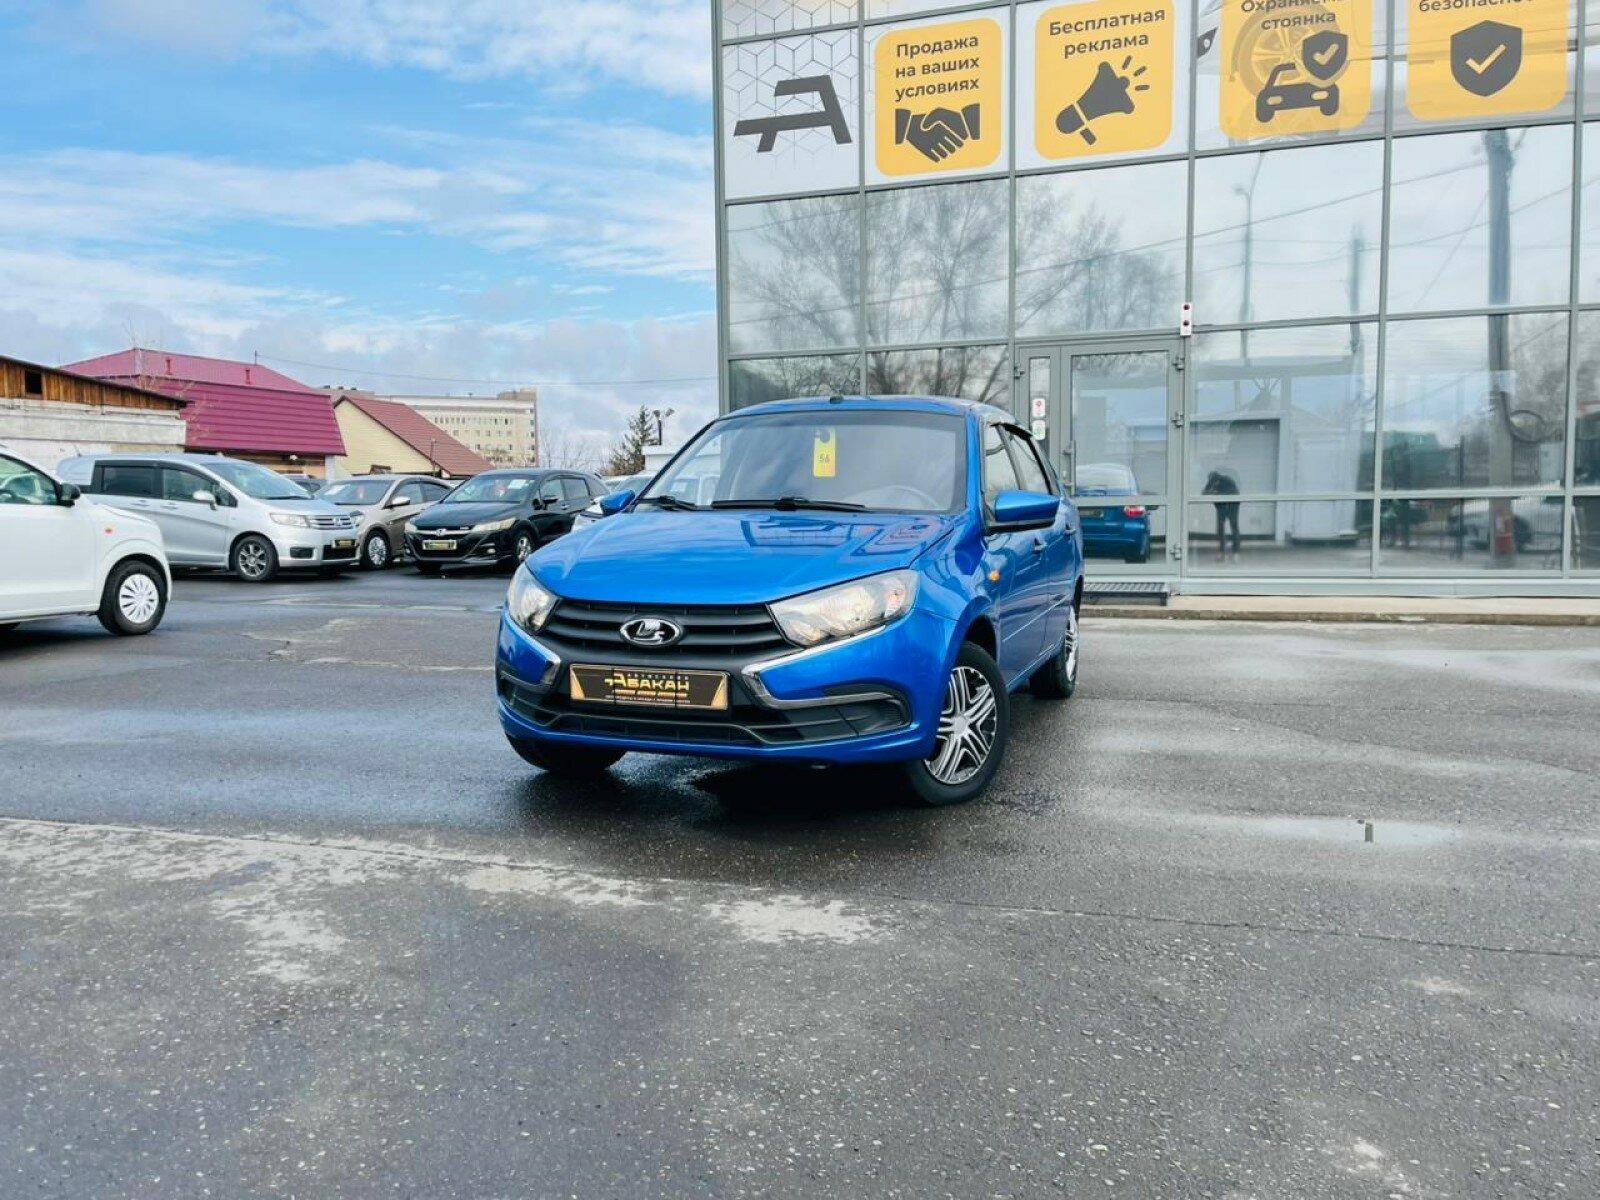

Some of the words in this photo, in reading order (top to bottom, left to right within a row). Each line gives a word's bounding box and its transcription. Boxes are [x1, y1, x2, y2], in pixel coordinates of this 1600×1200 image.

[1049, 9, 1166, 36] Бесплатная
[1261, 12, 1336, 30] стоянка
[896, 36, 979, 59] Продажа
[1064, 34, 1150, 59] реклама
[895, 66, 916, 78] на
[921, 58, 979, 75] ваших
[895, 79, 979, 102] условиях
